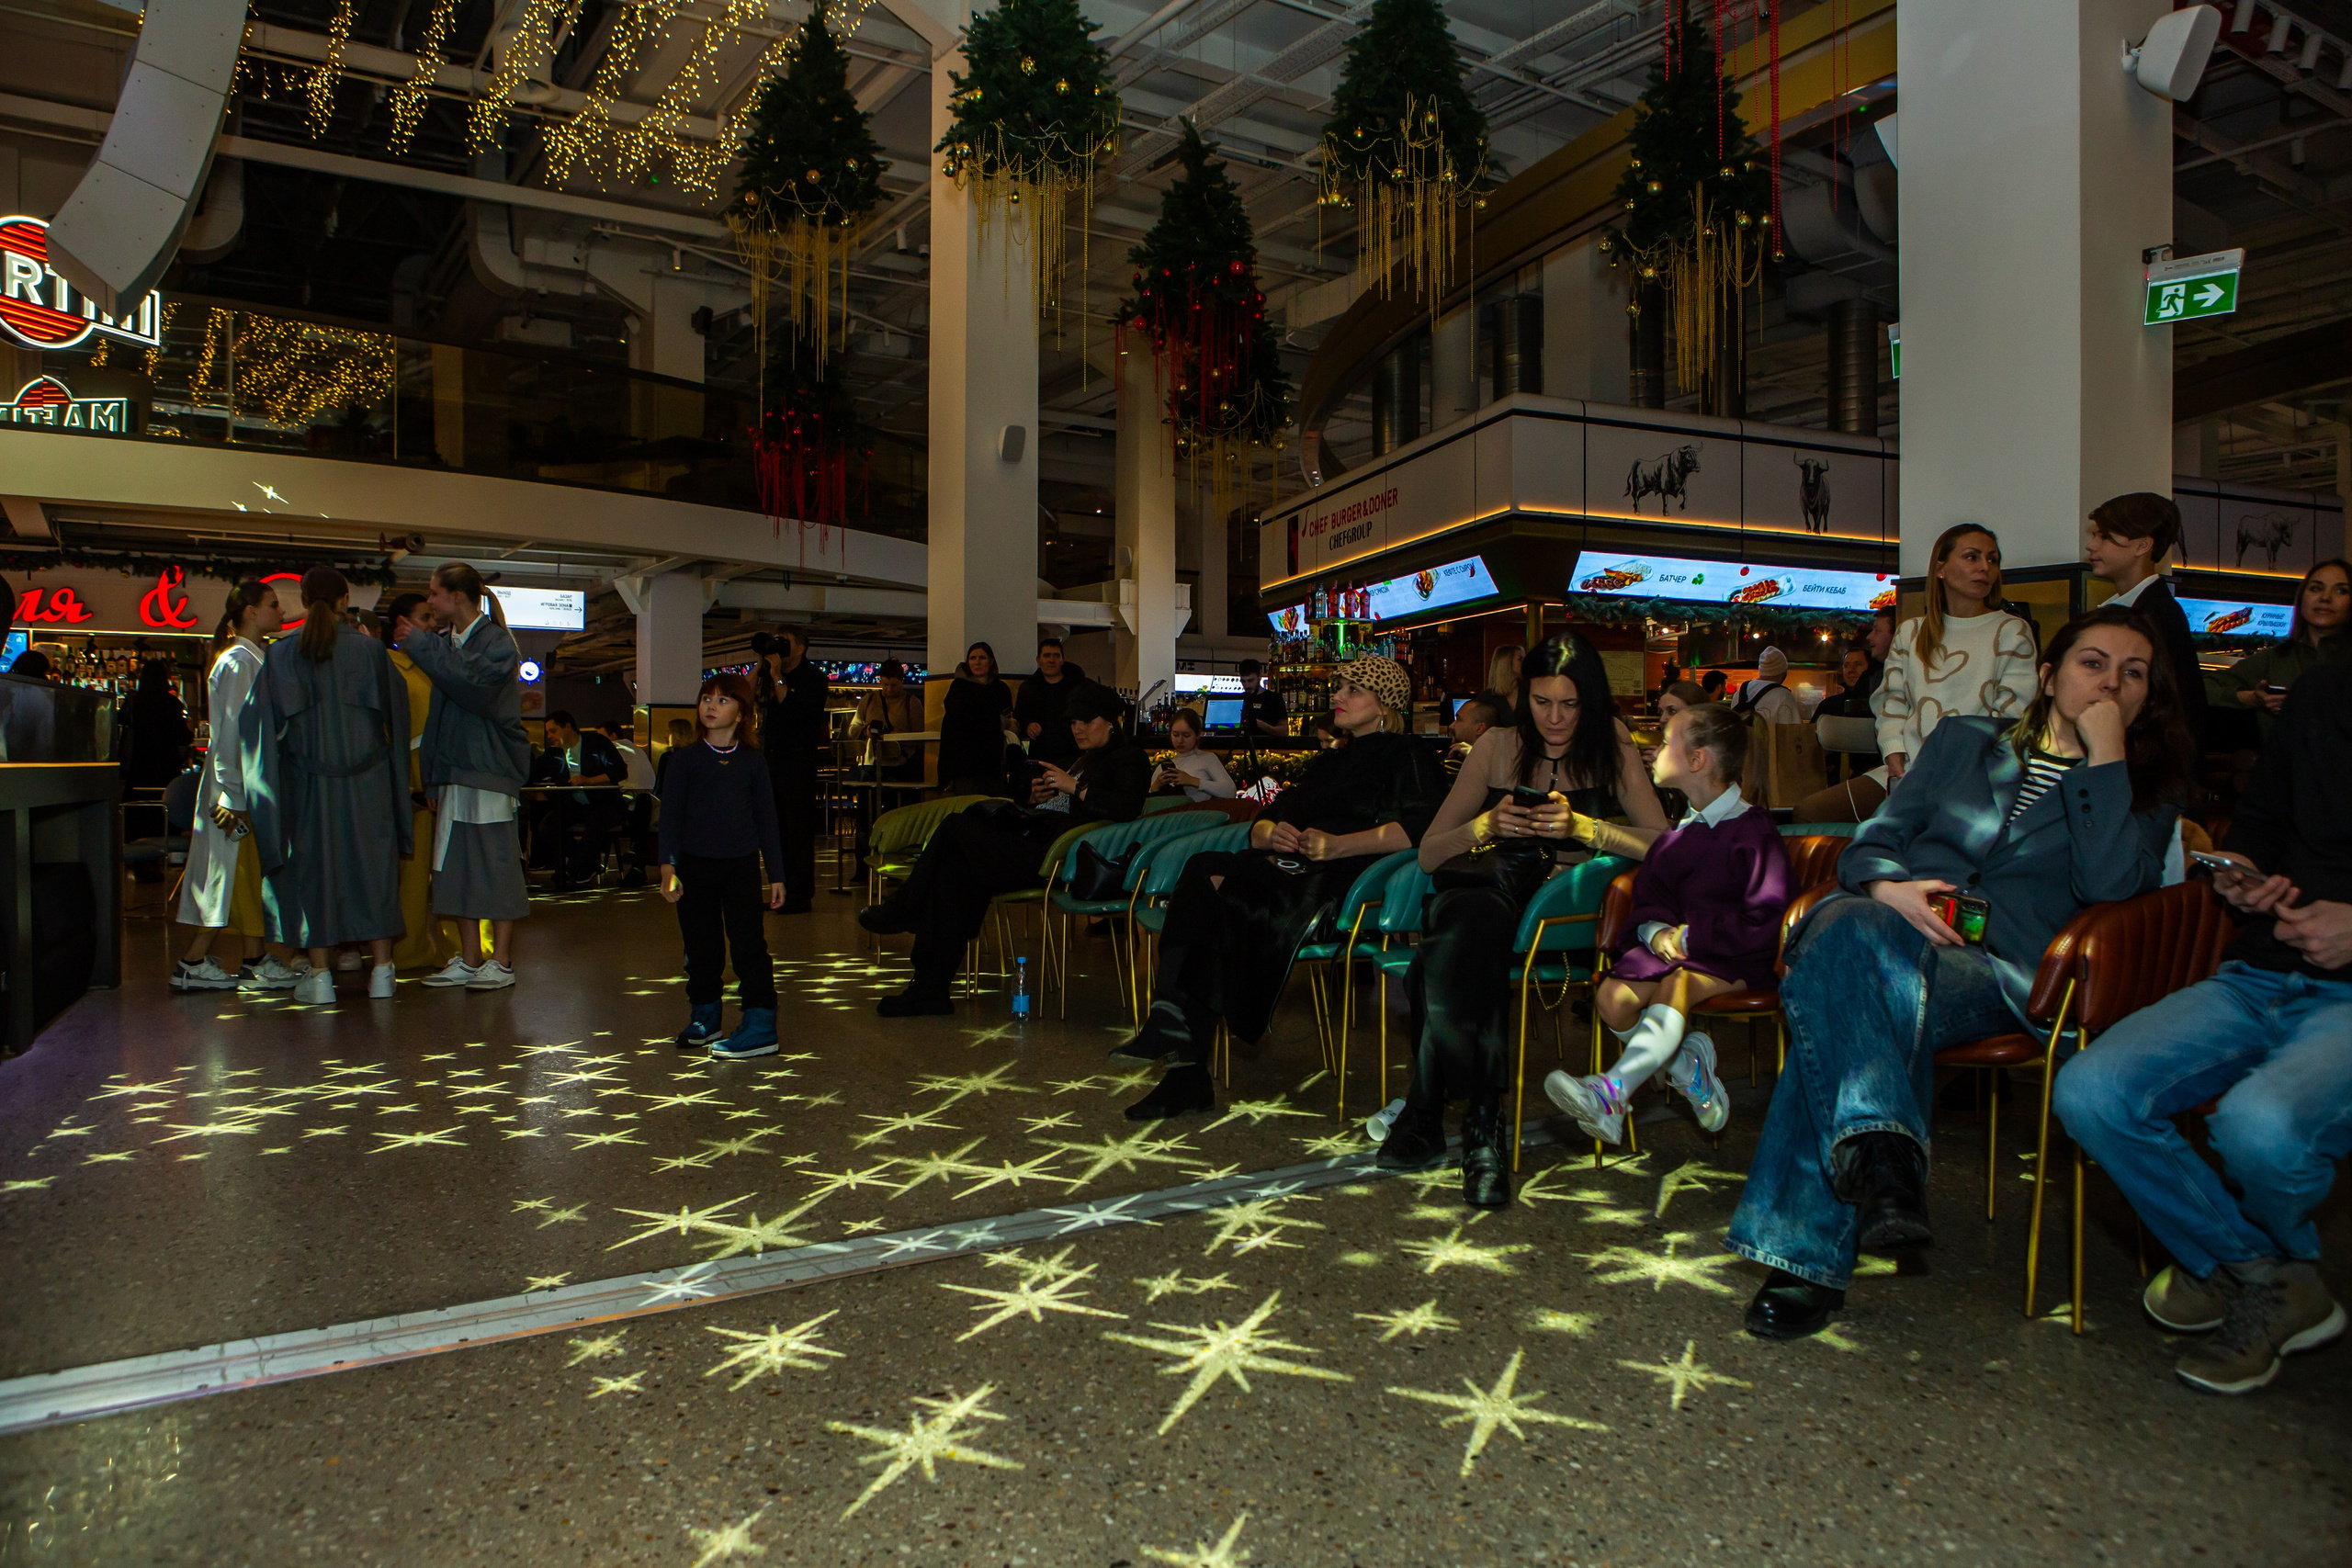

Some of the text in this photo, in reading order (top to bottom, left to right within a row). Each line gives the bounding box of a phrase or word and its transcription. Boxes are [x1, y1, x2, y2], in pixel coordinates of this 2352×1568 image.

[1309, 515, 1329, 537] CHEF
[1329, 521, 1373, 551] CHEFGROUP
[1658, 573, 1687, 583] БАТЧЕР
[1802, 583, 1847, 595] БЕЙТИ КЕБАБ
[13, 587, 93, 624] ля
